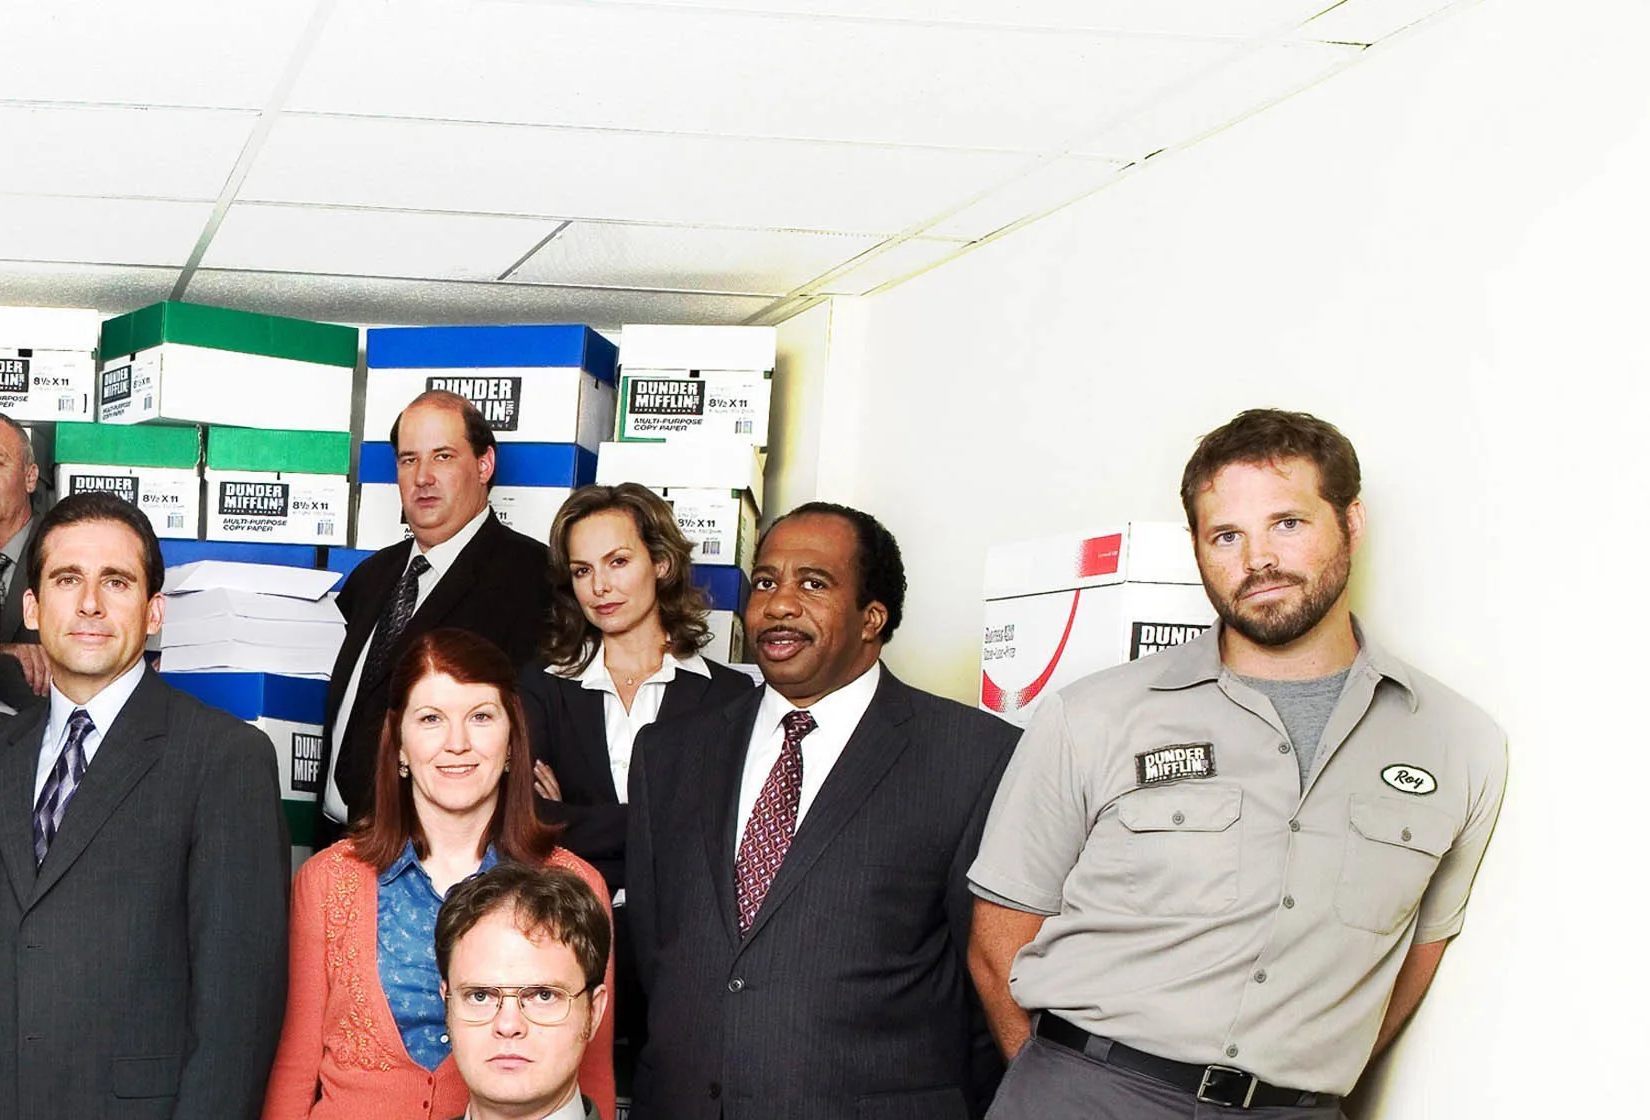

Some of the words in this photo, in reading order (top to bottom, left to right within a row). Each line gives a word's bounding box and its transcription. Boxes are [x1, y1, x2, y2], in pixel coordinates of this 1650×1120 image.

[61, 378, 69, 386] 11
[637, 381, 698, 395] DUNDER
[729, 399, 737, 407] X
[739, 399, 747, 407] 11
[75, 477, 132, 490] DUNDER
[226, 484, 282, 498] DUNDER
[162, 495, 168, 503] X
[697, 519, 704, 527] X
[1140, 625, 1210, 645] DUND
[1145, 747, 1204, 767] DUNDER
[294, 758, 319, 782] MIFF
[1394, 770, 1424, 789] Roy
